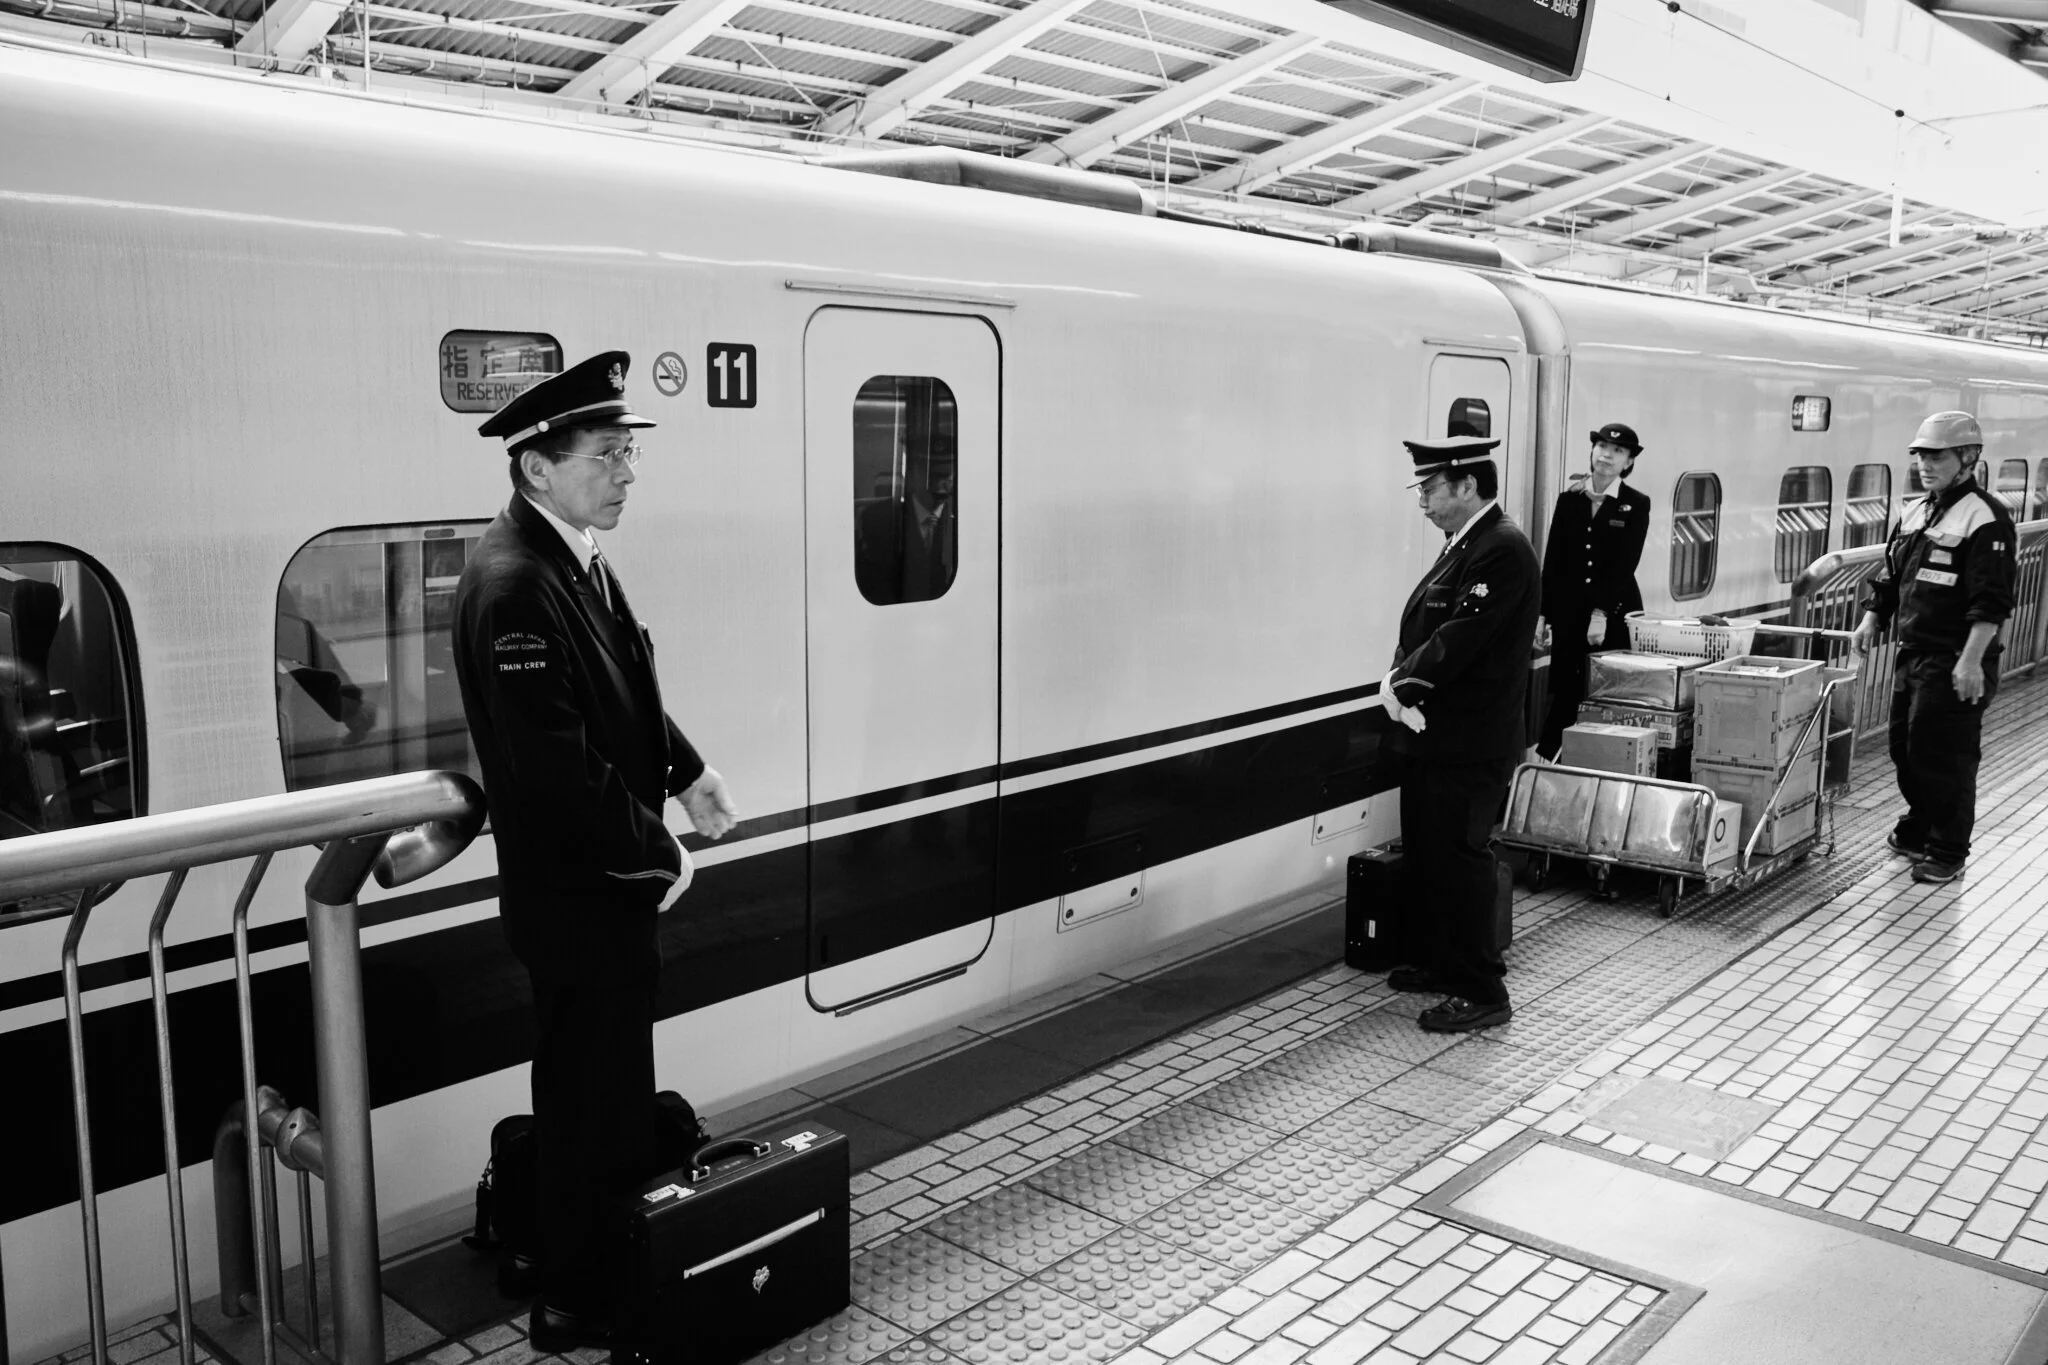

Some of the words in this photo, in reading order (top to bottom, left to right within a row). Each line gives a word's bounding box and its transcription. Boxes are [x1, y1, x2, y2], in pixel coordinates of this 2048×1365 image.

[713, 351, 748, 400] 11
[499, 663, 521, 672] TRAIN
[524, 661, 546, 670] CREW
